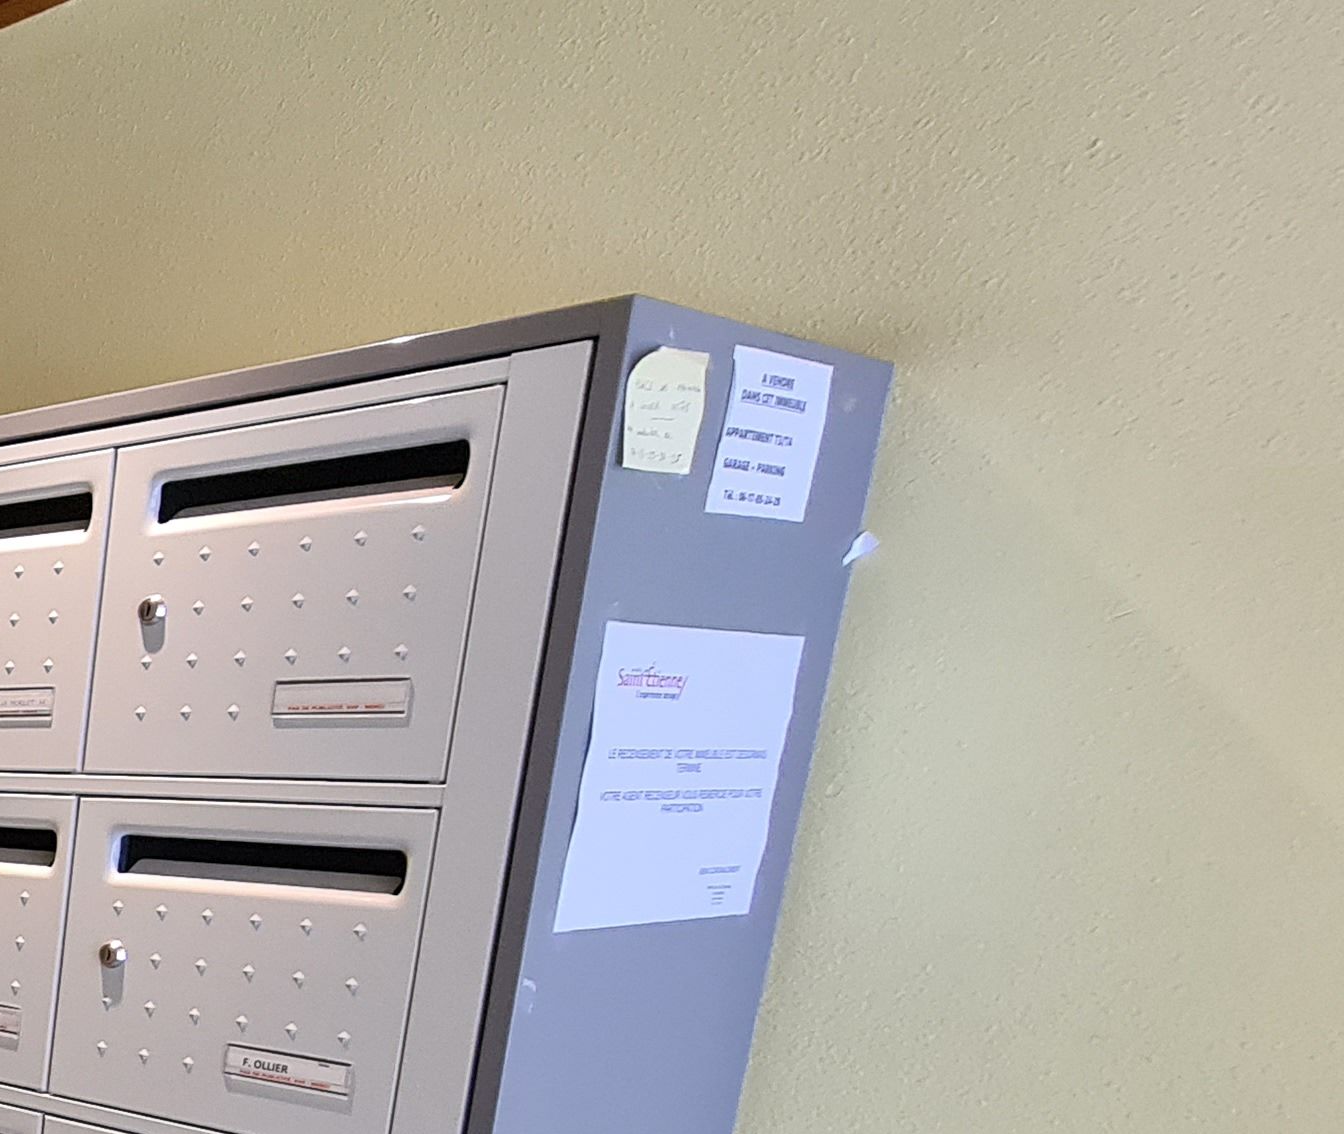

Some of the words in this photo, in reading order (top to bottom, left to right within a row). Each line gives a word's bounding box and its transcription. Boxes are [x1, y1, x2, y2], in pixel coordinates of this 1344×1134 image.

[768, 374, 796, 391] VENDRE
[740, 388, 762, 403] DANS
[761, 392, 775, 405] CET
[724, 426, 775, 443] APPARTEMENT
[722, 457, 751, 473] GARAGE
[756, 463, 786, 478] PARKING
[242, 1057, 251, 1067] F.
[254, 1060, 288, 1074] OLLIER
